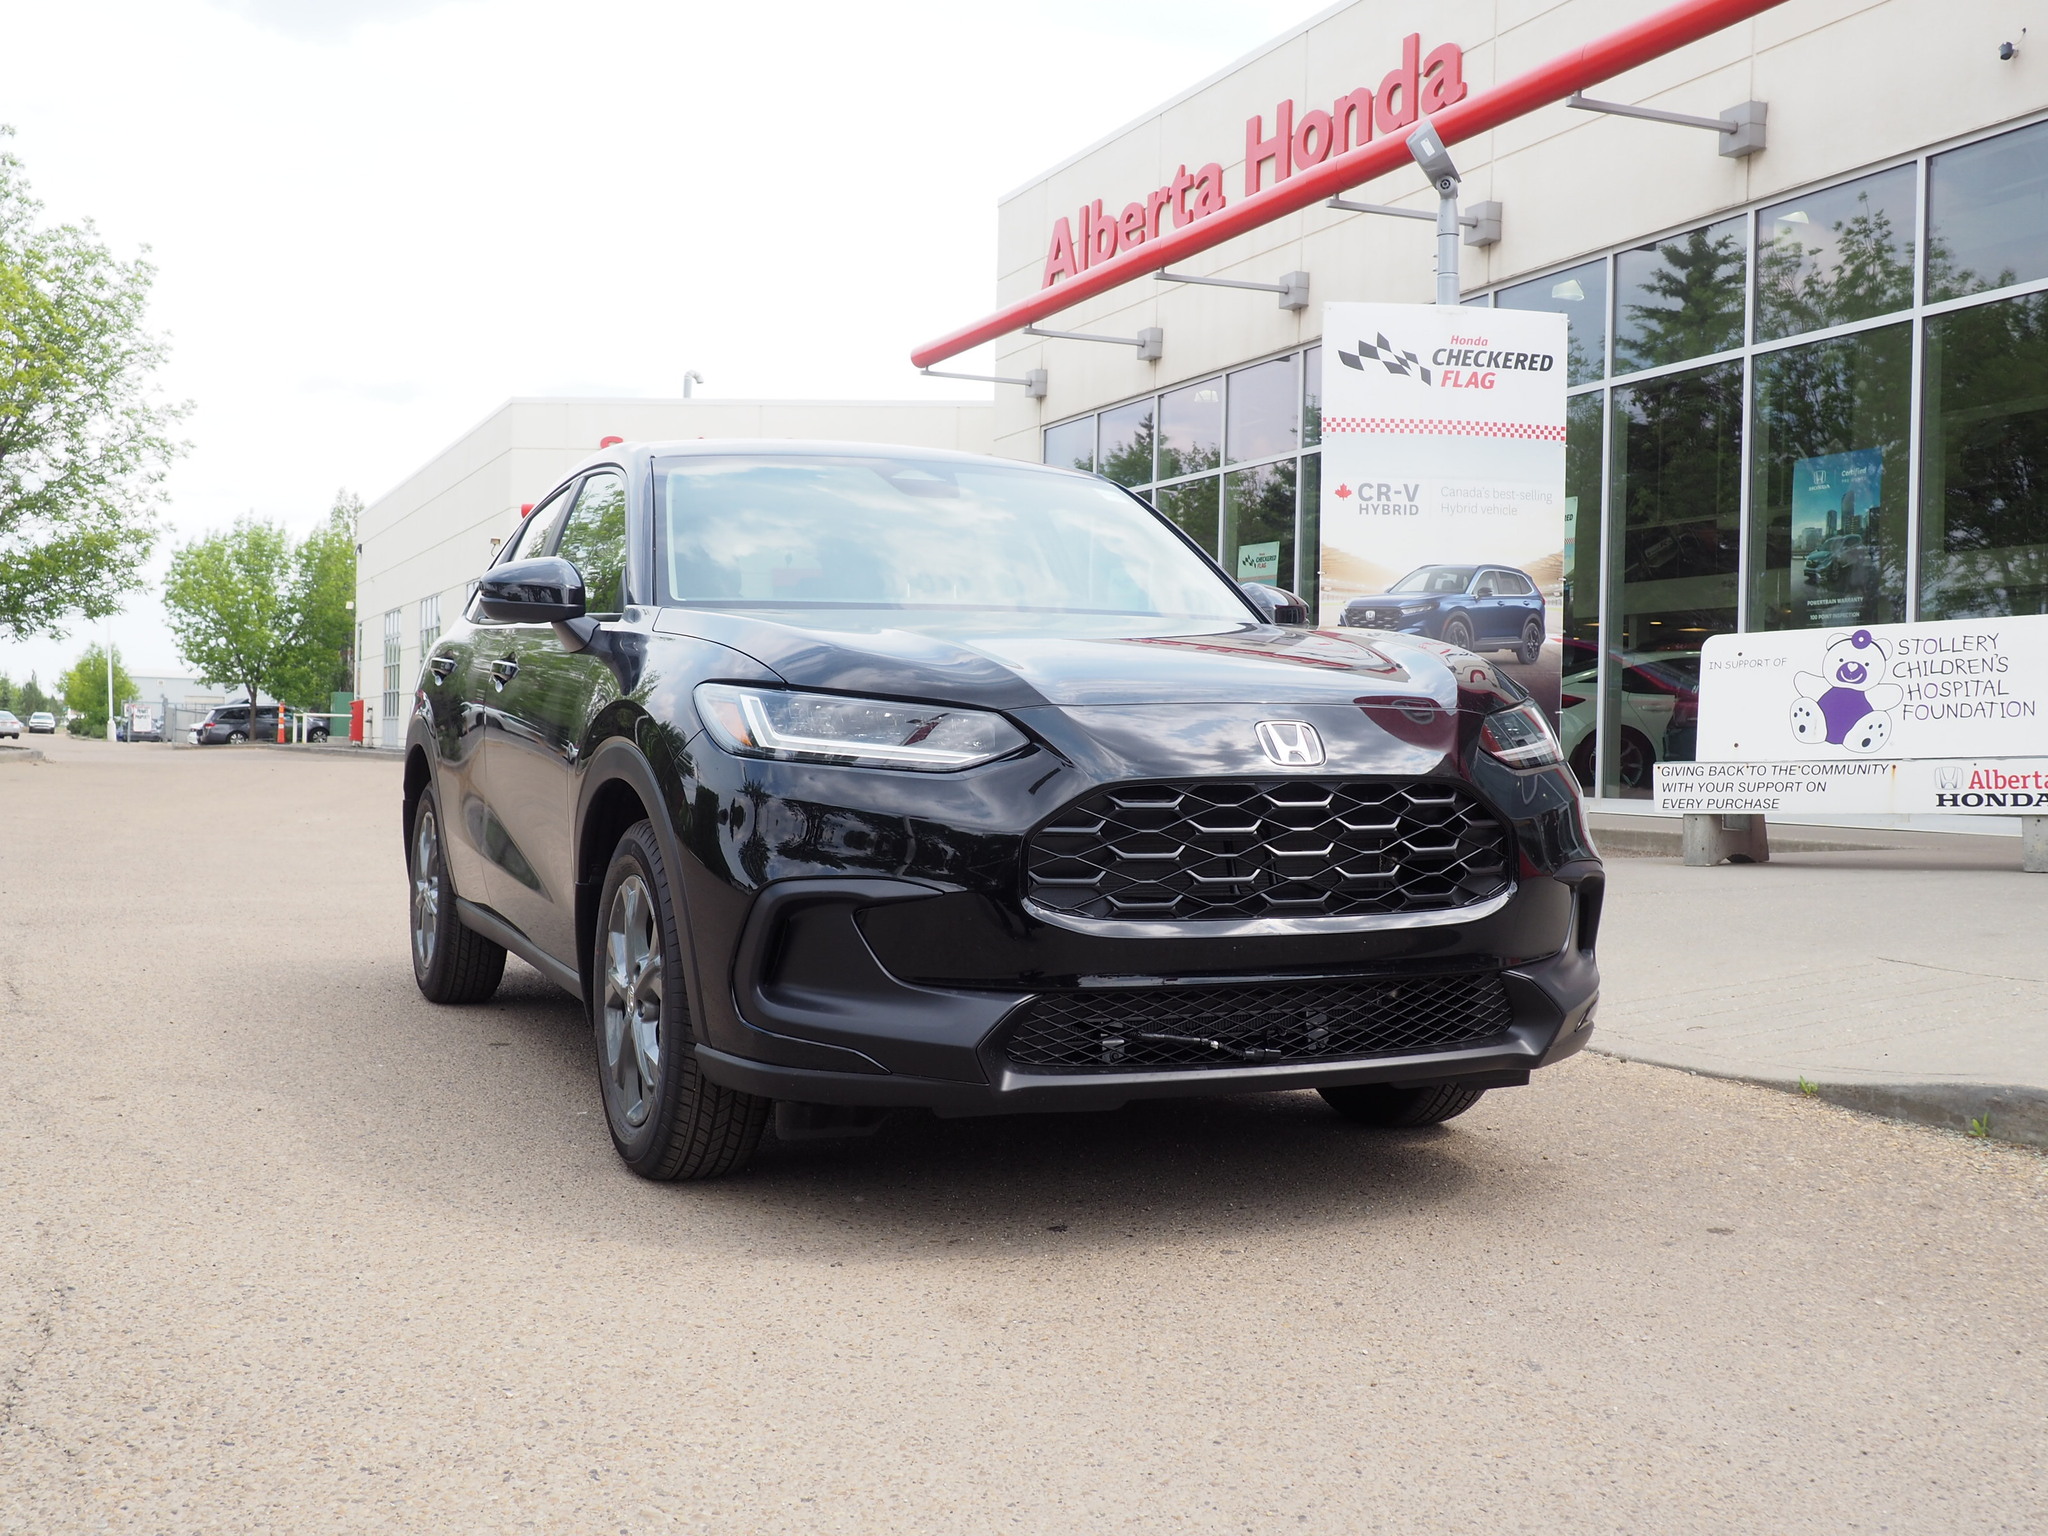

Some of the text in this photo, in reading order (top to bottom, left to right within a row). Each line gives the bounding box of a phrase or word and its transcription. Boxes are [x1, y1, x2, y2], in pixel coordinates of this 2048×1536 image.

[1042, 32, 1468, 289] Alberta Honda
[1450, 335, 1489, 347] Honda
[1432, 348, 1554, 372] CHECKERED
[1440, 369, 1497, 390] FLAG
[1357, 482, 1420, 503] CR-V
[1440, 486, 1553, 505] Canada's best-selling
[1358, 503, 1420, 516] HYBRID
[1440, 503, 1519, 517] Hybrid vehicle
[1898, 632, 1999, 656] STOLLERY
[1709, 657, 1787, 670] IN SUPPORT OF
[1892, 653, 2009, 679] CHILDREN'S
[1907, 679, 2010, 701] HOSPITAL
[1903, 700, 2036, 721] FOUNDATION
[1661, 763, 1889, 777] GIVING BACK TO THE COMMUNITY
[1662, 781, 1827, 793] WITH YOUR SUPPORT ON
[1662, 798, 1780, 809] EVERY PURCHASE
